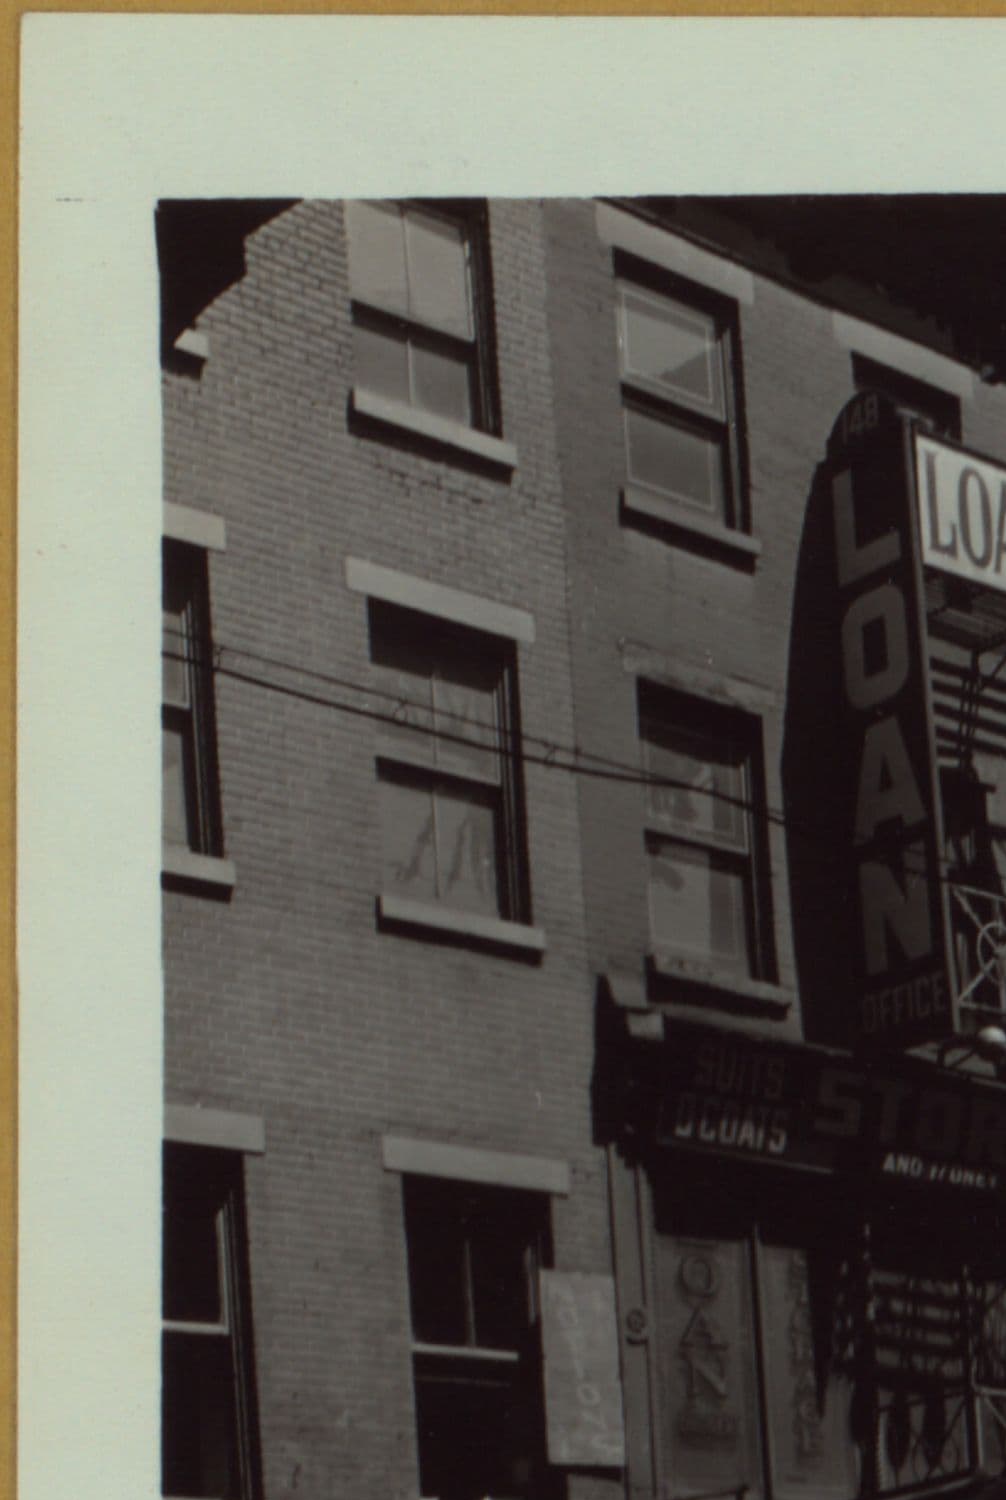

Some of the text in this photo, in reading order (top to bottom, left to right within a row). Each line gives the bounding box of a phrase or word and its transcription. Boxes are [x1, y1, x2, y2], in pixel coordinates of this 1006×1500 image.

[831, 467, 934, 978] LOAN
[861, 968, 949, 1033] OFFICE
[696, 1044, 786, 1100] SUITS
[881, 1151, 924, 1179] AND
